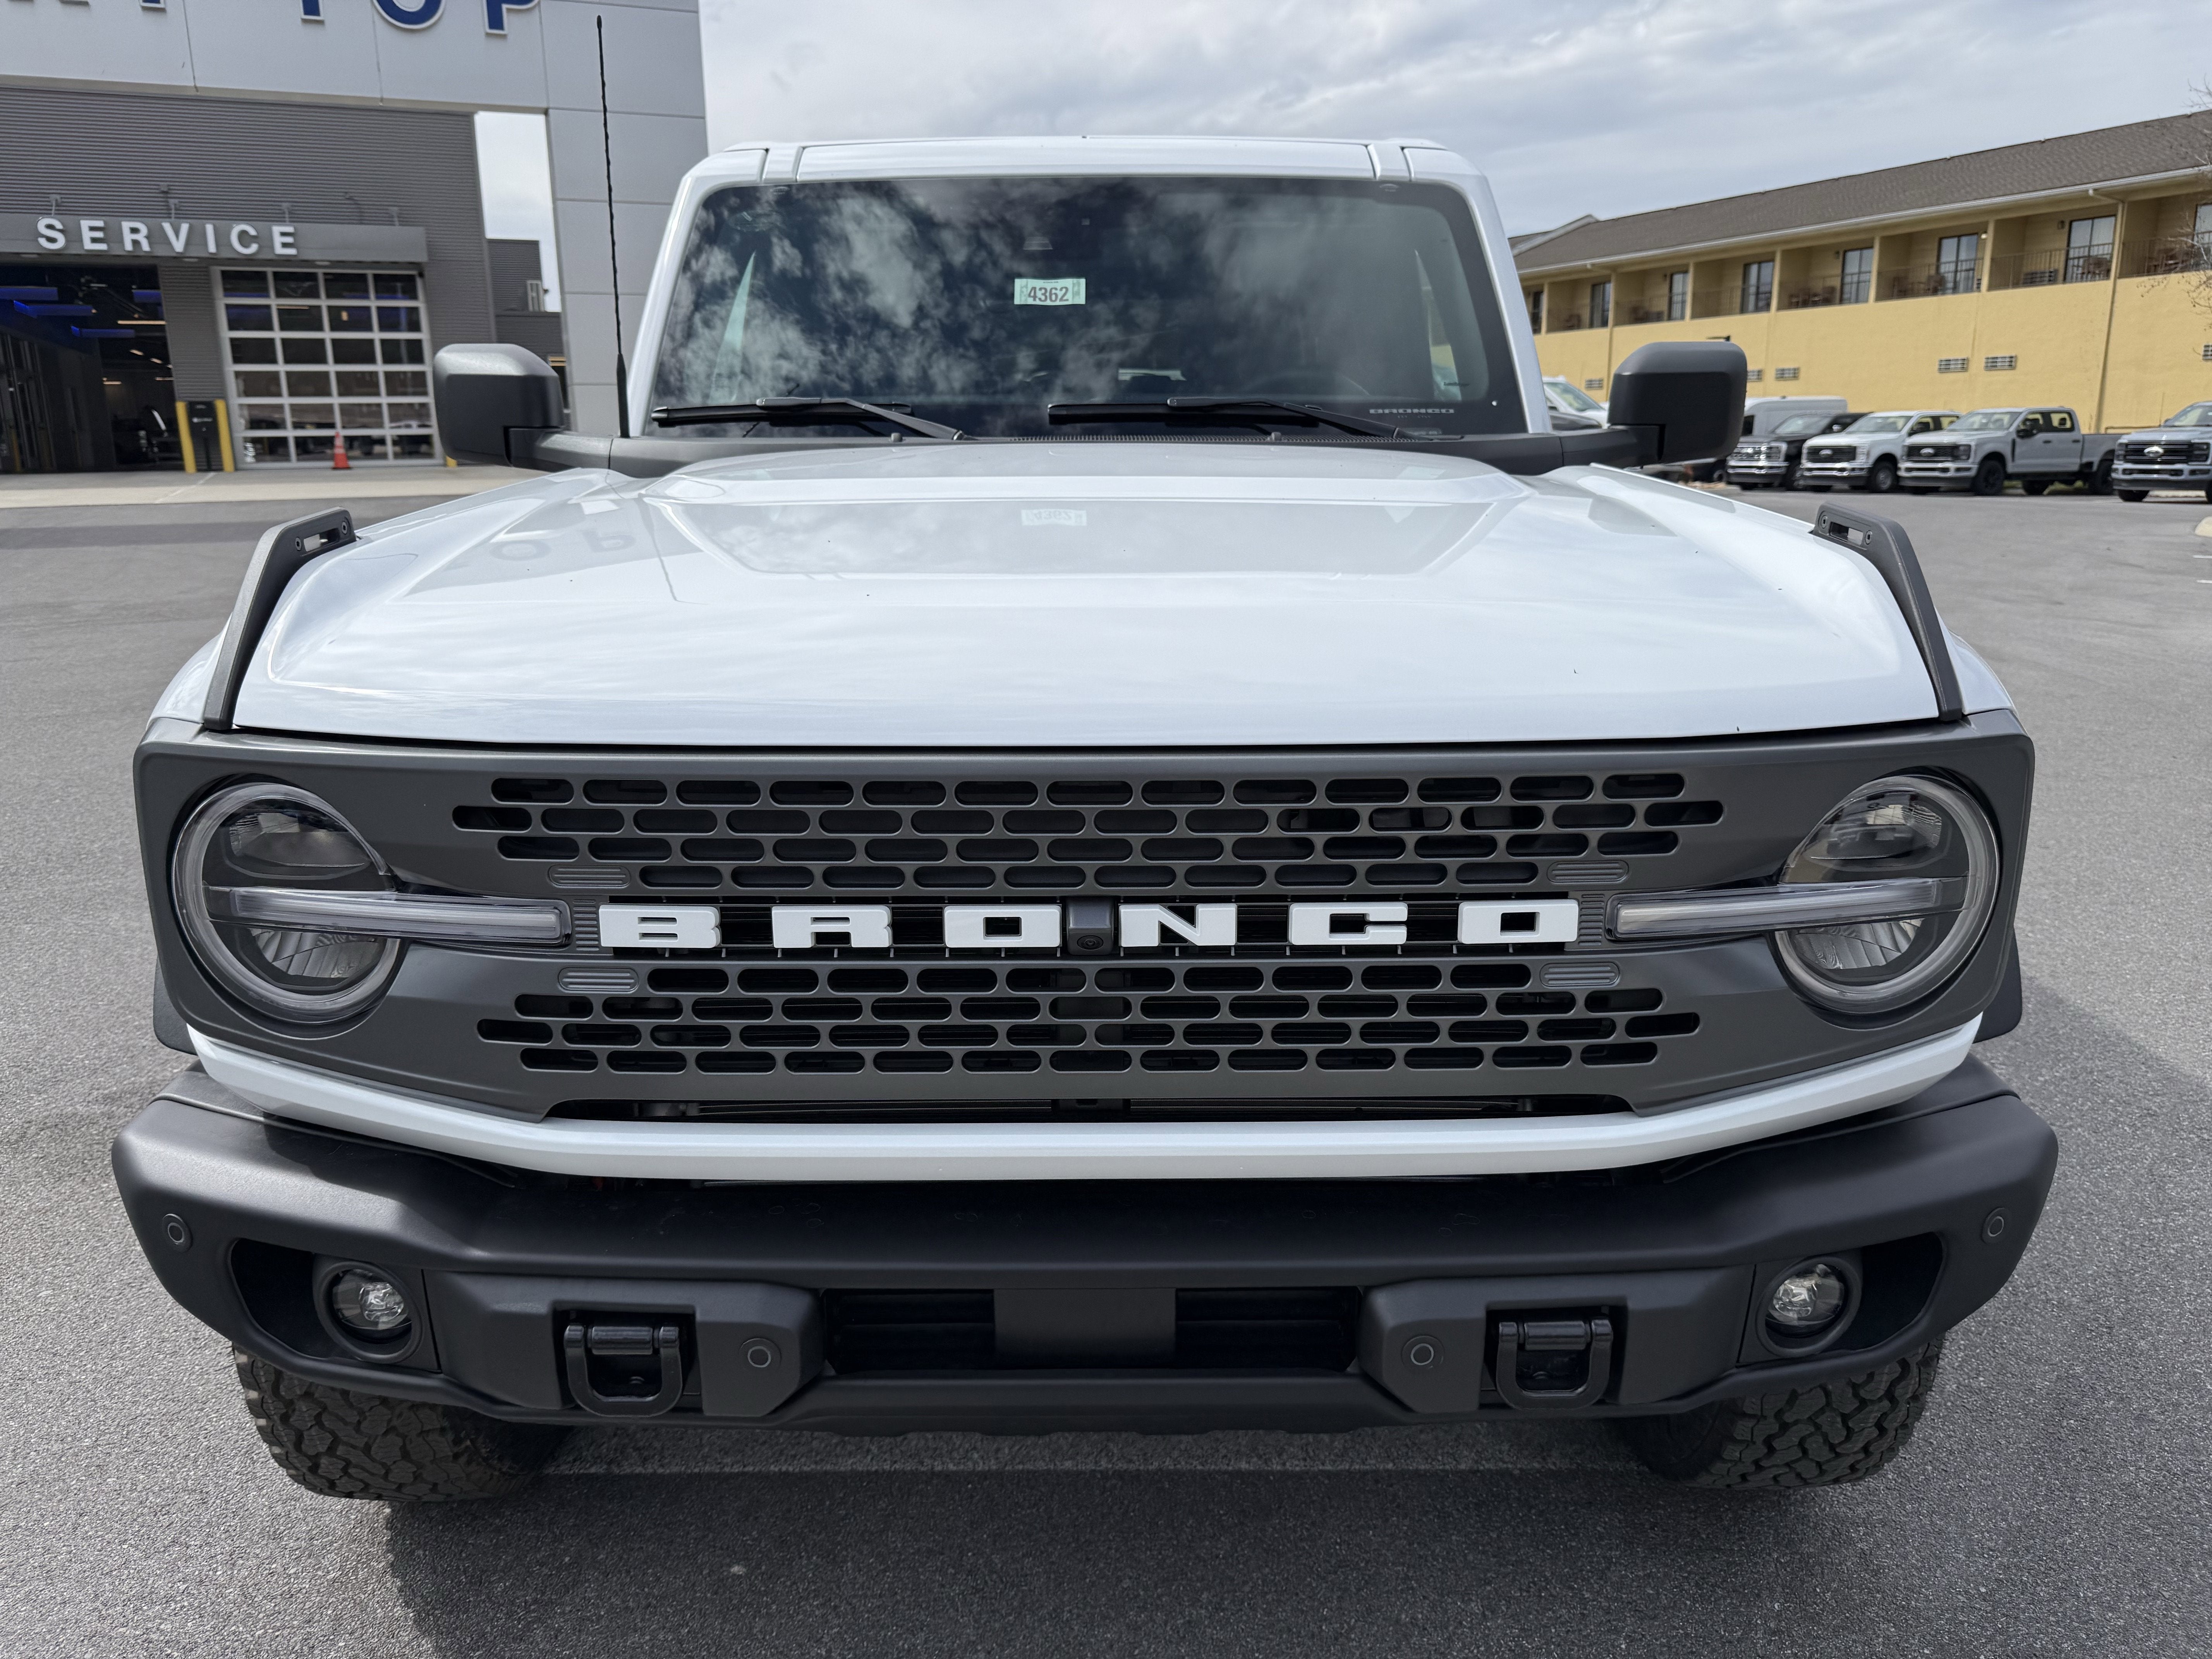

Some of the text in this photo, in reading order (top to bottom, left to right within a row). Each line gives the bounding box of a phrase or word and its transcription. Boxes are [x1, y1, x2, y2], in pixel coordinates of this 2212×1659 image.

[36, 216, 298, 255] SERVICE
[1028, 287, 1069, 302] 4362
[599, 898, 1578, 948] BRONCO
